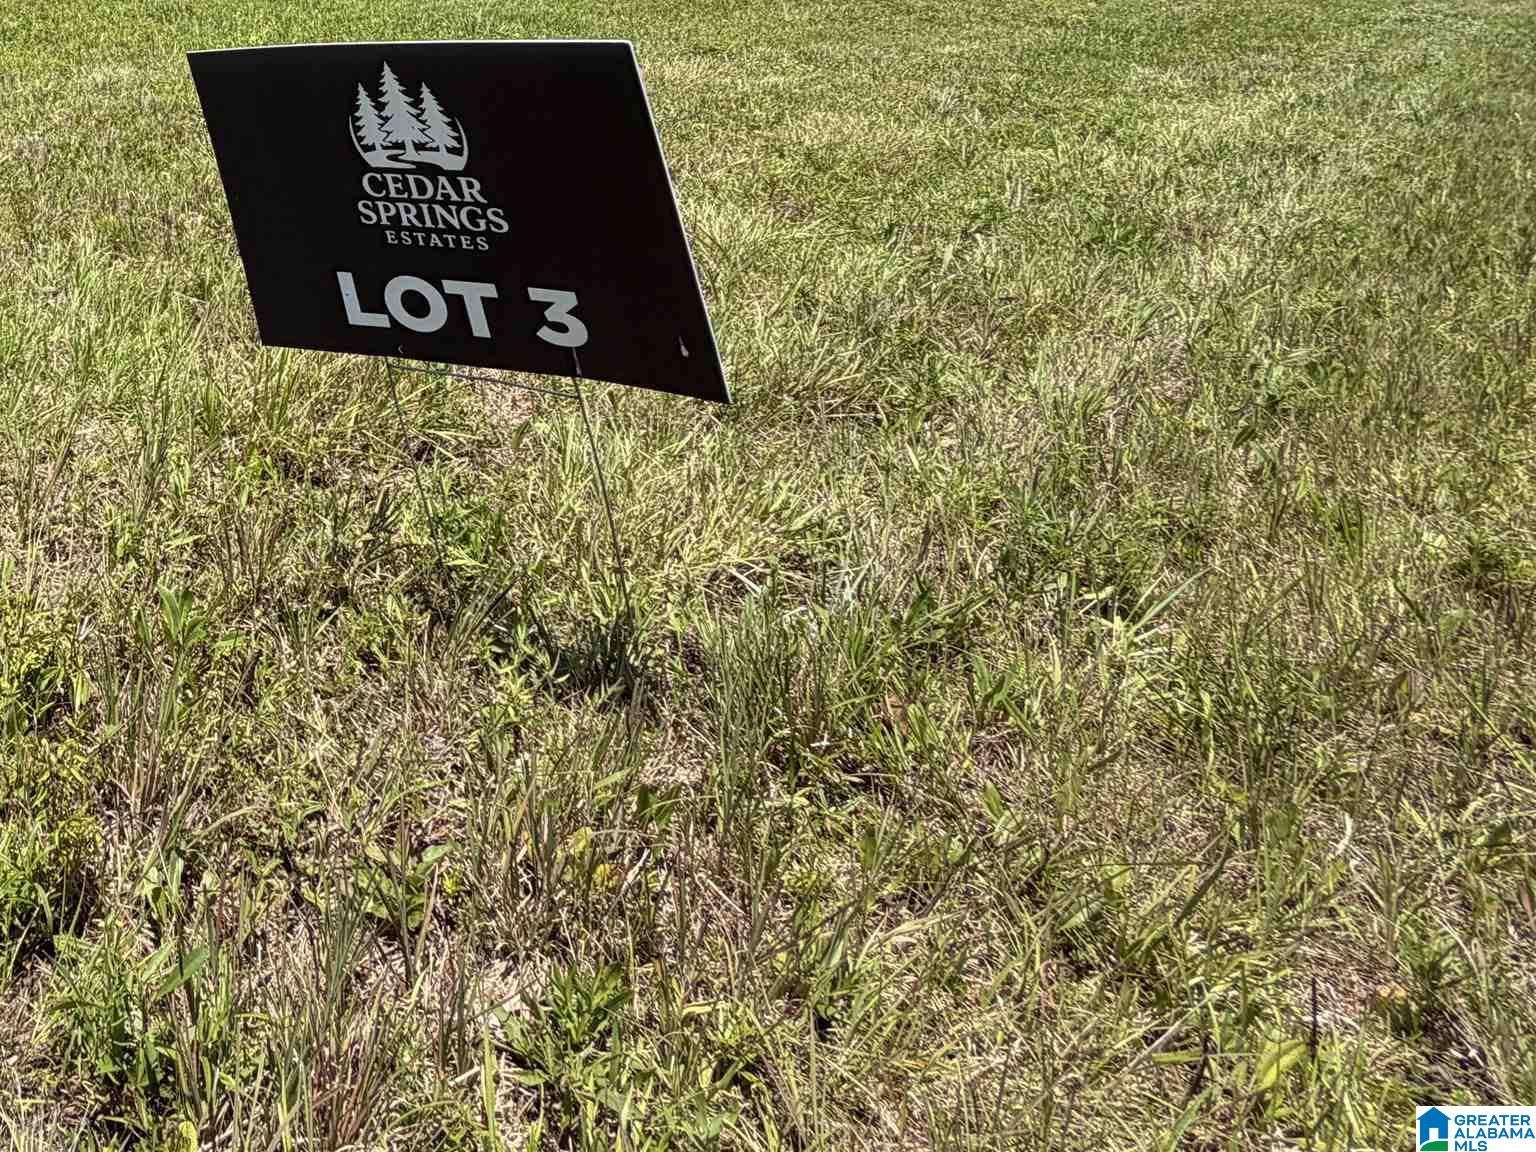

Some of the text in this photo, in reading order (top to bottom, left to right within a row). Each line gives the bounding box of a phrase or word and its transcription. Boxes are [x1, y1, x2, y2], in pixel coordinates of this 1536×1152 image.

[362, 173, 488, 204] CEDAR
[357, 199, 509, 233] SPRINGS
[385, 230, 489, 251] ESTATES
[336, 271, 588, 348] LOT 3
